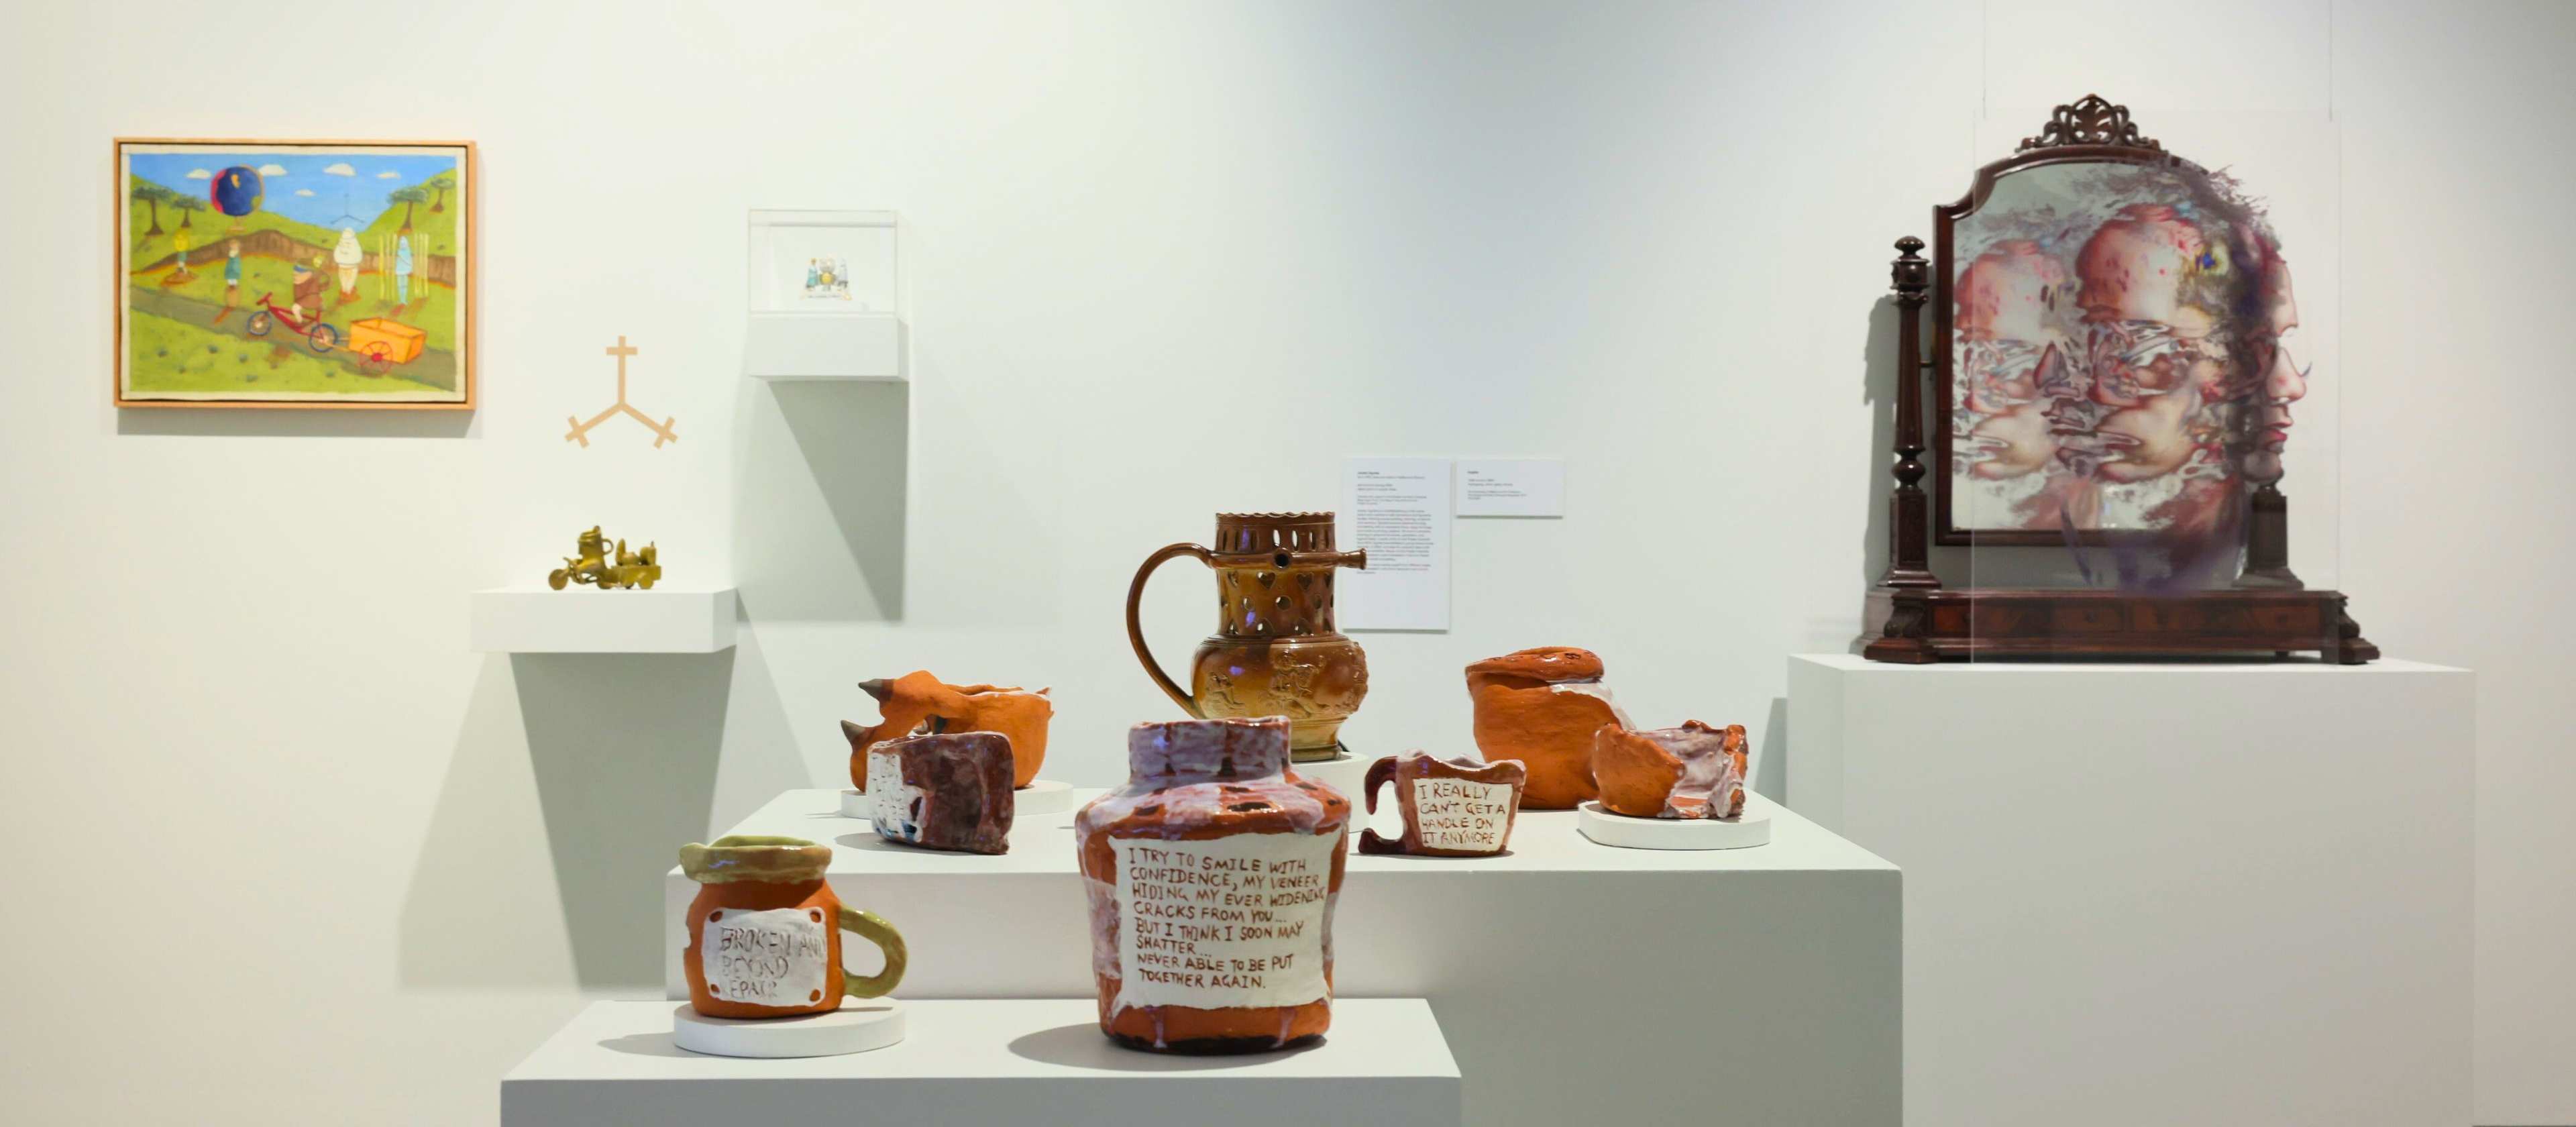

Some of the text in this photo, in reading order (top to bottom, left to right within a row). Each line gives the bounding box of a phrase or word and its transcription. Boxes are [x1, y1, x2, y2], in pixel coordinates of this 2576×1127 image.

[1419, 782, 1492, 800] I REALLY
[1419, 800, 1506, 815] CAN'T GET A
[1422, 818, 1493, 829] HANDLE ON
[1423, 830, 1495, 845] IT ANYMORE
[1128, 847, 1306, 874] I TRY TO SMILE WITH
[1130, 867, 1320, 892] CONFIDENCE, MY VENEER
[1132, 884, 1324, 908] HIDING MY EVER WIDENING
[1134, 901, 1195, 919] CRACKS
[1201, 908, 1244, 922] FROM
[1134, 917, 1305, 941] BUT I THINK I SOON MAY
[720, 928, 792, 956] BROKEN
[1138, 953, 1294, 971] NEVER ABLE TO BE PUT
[1138, 969, 1267, 989] TOGETHER AGAIN.
